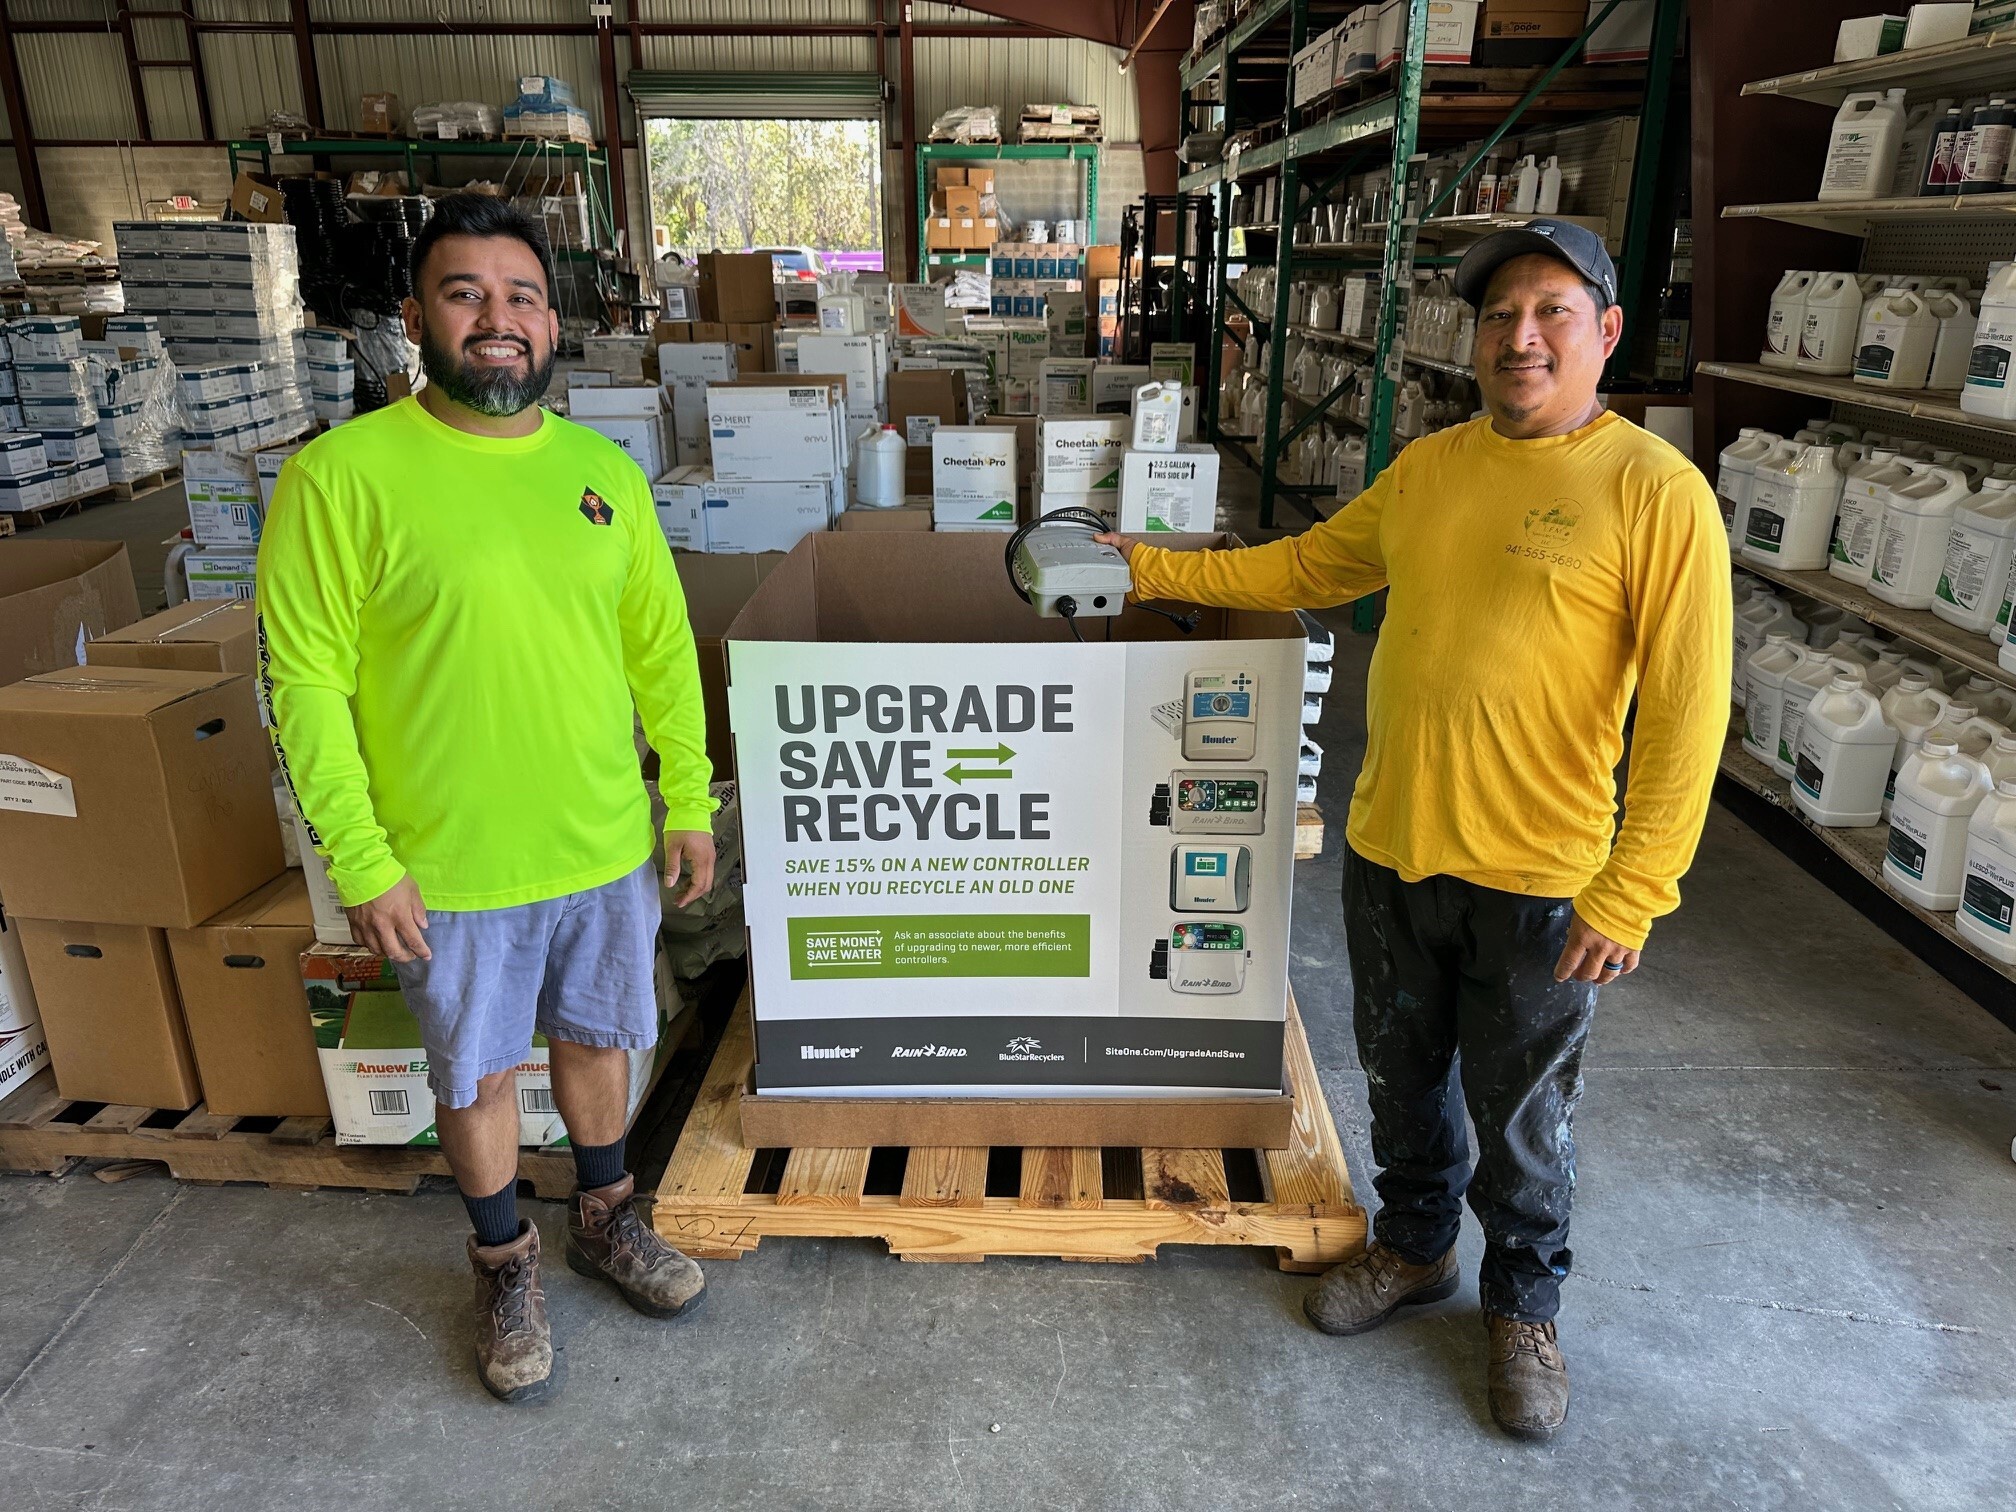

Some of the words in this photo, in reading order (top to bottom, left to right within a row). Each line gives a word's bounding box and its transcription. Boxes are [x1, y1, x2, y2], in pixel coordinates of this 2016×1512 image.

[176, 197, 191, 208] EXIT
[1012, 331, 1047, 342] Ranger
[724, 416, 751, 424] MERIT
[804, 435, 828, 443] envu
[1055, 439, 1098, 448] Cheetah
[1104, 439, 1122, 447] Pro
[943, 457, 984, 466] Cheetah
[989, 458, 1006, 466] Pro
[718, 487, 745, 495] MERIT
[1100, 509, 1117, 518] Pro
[1505, 544, 1582, 570] 941-565-5680
[774, 684, 1074, 734] UPGRADE
[1202, 735, 1237, 744] Hunter
[779, 740, 933, 790] SAVE
[783, 793, 1051, 842] RECYCLE
[1192, 816, 1214, 825] RAIN
[785, 859, 830, 874] SAVE
[834, 858, 876, 873] 15%
[881, 858, 906, 873] ON
[911, 858, 923, 872] A
[927, 858, 969, 872] NEW
[973, 857, 1090, 871] CONTROLLER
[786, 881, 841, 897] WHEN
[846, 881, 882, 896] YOU
[887, 880, 966, 895] RECYCLE
[969, 880, 994, 894] AN
[999, 880, 1034, 894] OLD
[1038, 880, 1075, 894] ONE
[894, 930, 912, 940] Ask
[914, 932, 926, 940] an
[928, 931, 975, 940] associate
[977, 930, 1006, 939] about
[1007, 930, 1024, 939] the
[1026, 930, 1066, 939] benefits
[806, 937, 838, 949] SAVE
[839, 936, 884, 948] MONEY
[895, 942, 905, 952] of
[907, 942, 956, 955] upgrading
[958, 943, 969, 952] to
[971, 943, 1002, 953] newer,
[1004, 943, 1030, 951] more
[1032, 942, 1072, 951] efficient
[806, 949, 838, 961] SAVE
[840, 949, 882, 960] WATER
[895, 955, 950, 965] controllers.
[1181, 979, 1202, 987] RAIN
[1211, 979, 1232, 988] BIRD
[16, 1048, 36, 1071] WITH
[35, 1039, 49, 1056] CA
[800, 1045, 862, 1060] Hunter
[891, 1046, 923, 1058] RAIN
[1105, 1047, 1246, 1059] SiteOne.Com/UpgradeAndSave
[999, 1053, 1065, 1063] BlueStarRecyclers
[356, 1062, 408, 1073] Anuew
[409, 1061, 429, 1072] EZ
